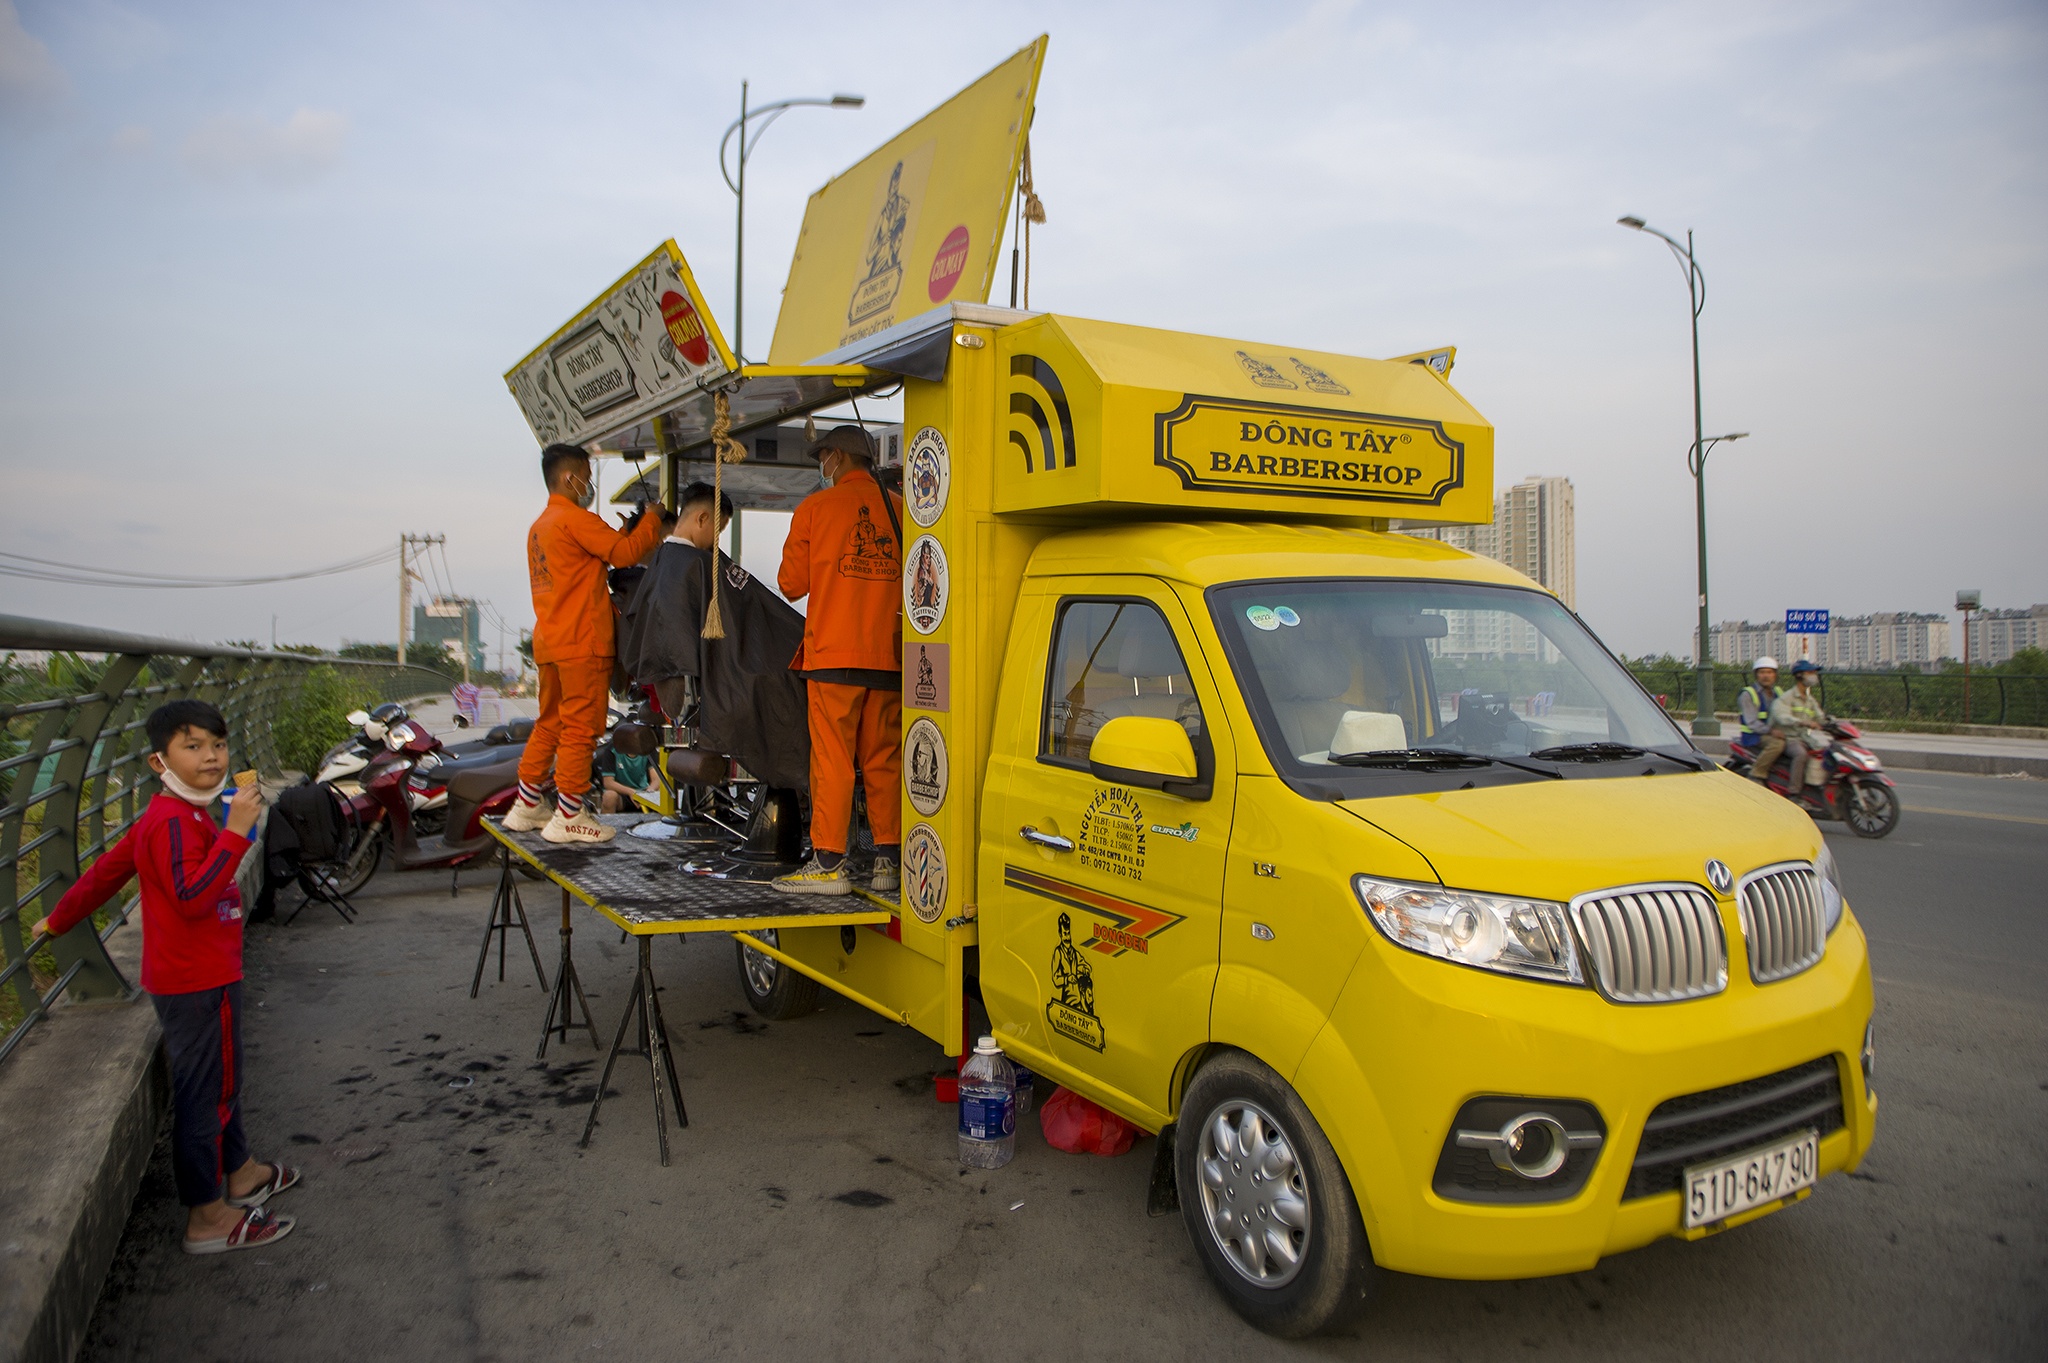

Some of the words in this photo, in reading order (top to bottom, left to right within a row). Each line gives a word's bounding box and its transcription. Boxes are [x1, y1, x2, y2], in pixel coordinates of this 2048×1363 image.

[574, 369, 624, 405] BARBERSHOP
[1239, 419, 1332, 449] ĐÔNG
[908, 430, 930, 464] BARBER
[930, 431, 946, 457] SHOP
[1210, 451, 1422, 486] BARBERSHOP
[843, 565, 873, 575] BARBER
[565, 824, 601, 838] BOSTON
[1093, 825, 1109, 837] TLCP:
[1094, 816, 1110, 827] TLBT:
[1131, 802, 1146, 855] THANH
[909, 828, 940, 851] BARBERSHOP
[1092, 835, 1109, 847] TLTB:
[1093, 858, 1110, 873] 0972
[1113, 863, 1126, 876] 730
[1128, 868, 1142, 881] 732
[910, 895, 939, 918] AMSTERDAM
[1093, 922, 1149, 955] DONGBEN
[1055, 1019, 1096, 1044] BARBERSHOP
